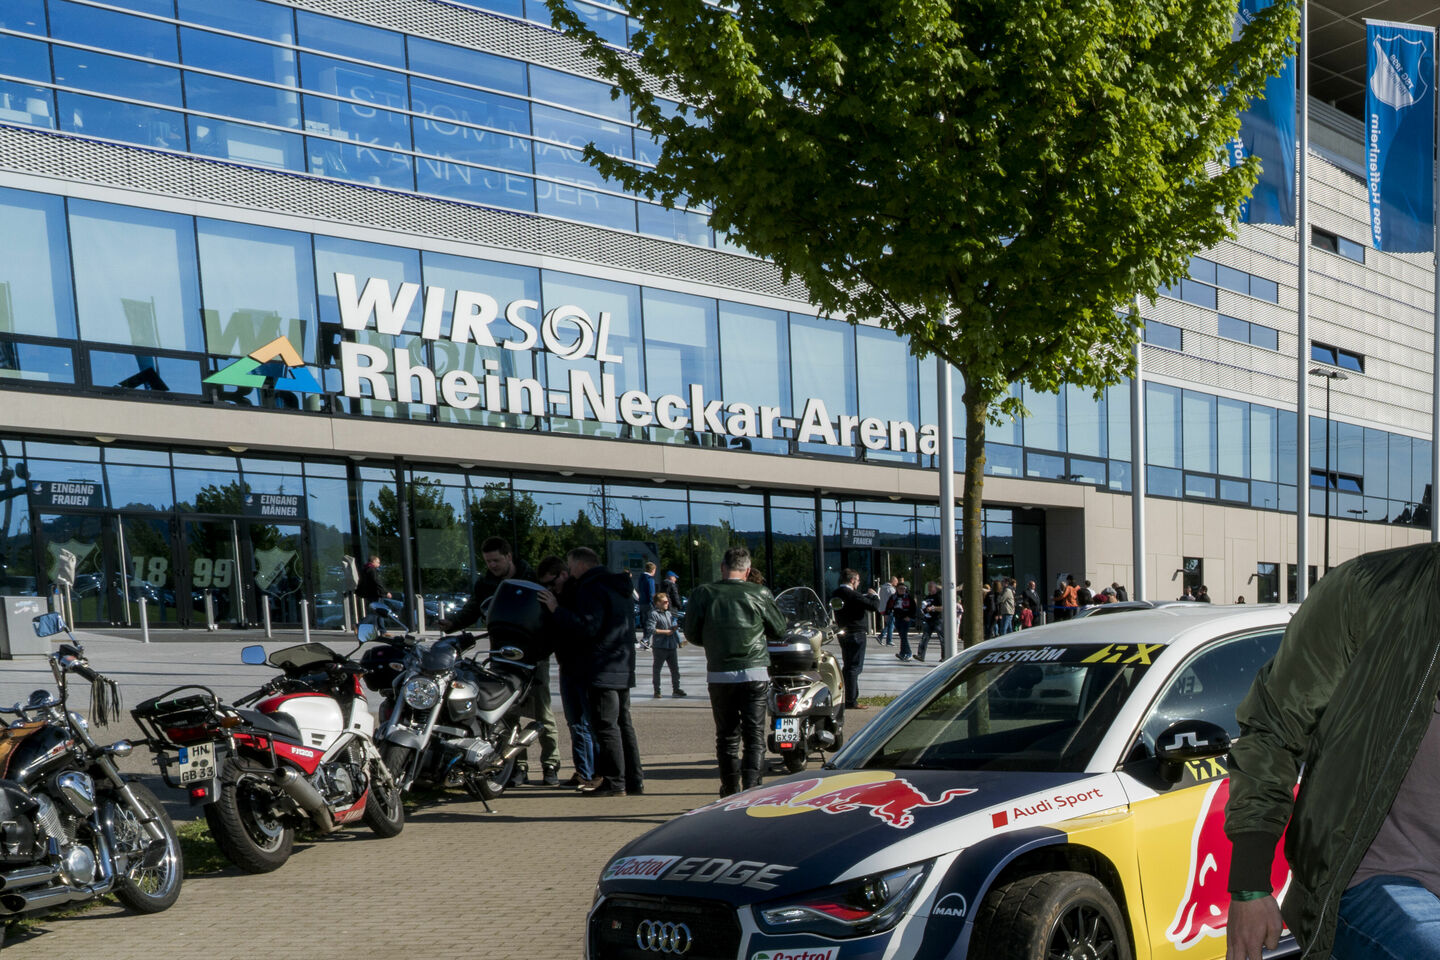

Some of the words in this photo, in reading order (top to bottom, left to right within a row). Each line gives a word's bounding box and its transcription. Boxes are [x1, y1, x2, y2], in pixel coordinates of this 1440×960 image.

[355, 132, 473, 186] KANN
[334, 272, 623, 362] WIRSOL
[340, 341, 939, 456] Rhein-Neckar-Arena
[51, 483, 94, 495] EINGANG
[52, 495, 89, 506] FRAUEN
[260, 495, 298, 506] EINGANG
[261, 503, 298, 516] MÄNNER
[131, 556, 168, 588] 18
[193, 558, 232, 588] 99
[978, 645, 1067, 664] EKSTRÖM
[192, 745, 210, 757] HN
[182, 769, 197, 783] GB
[199, 766, 214, 779] 33
[1012, 799, 1053, 821] Audi
[1054, 787, 1104, 812] Sport
[614, 857, 675, 877] Castrol
[662, 858, 800, 891] EDGE
[935, 906, 965, 917] MAN
